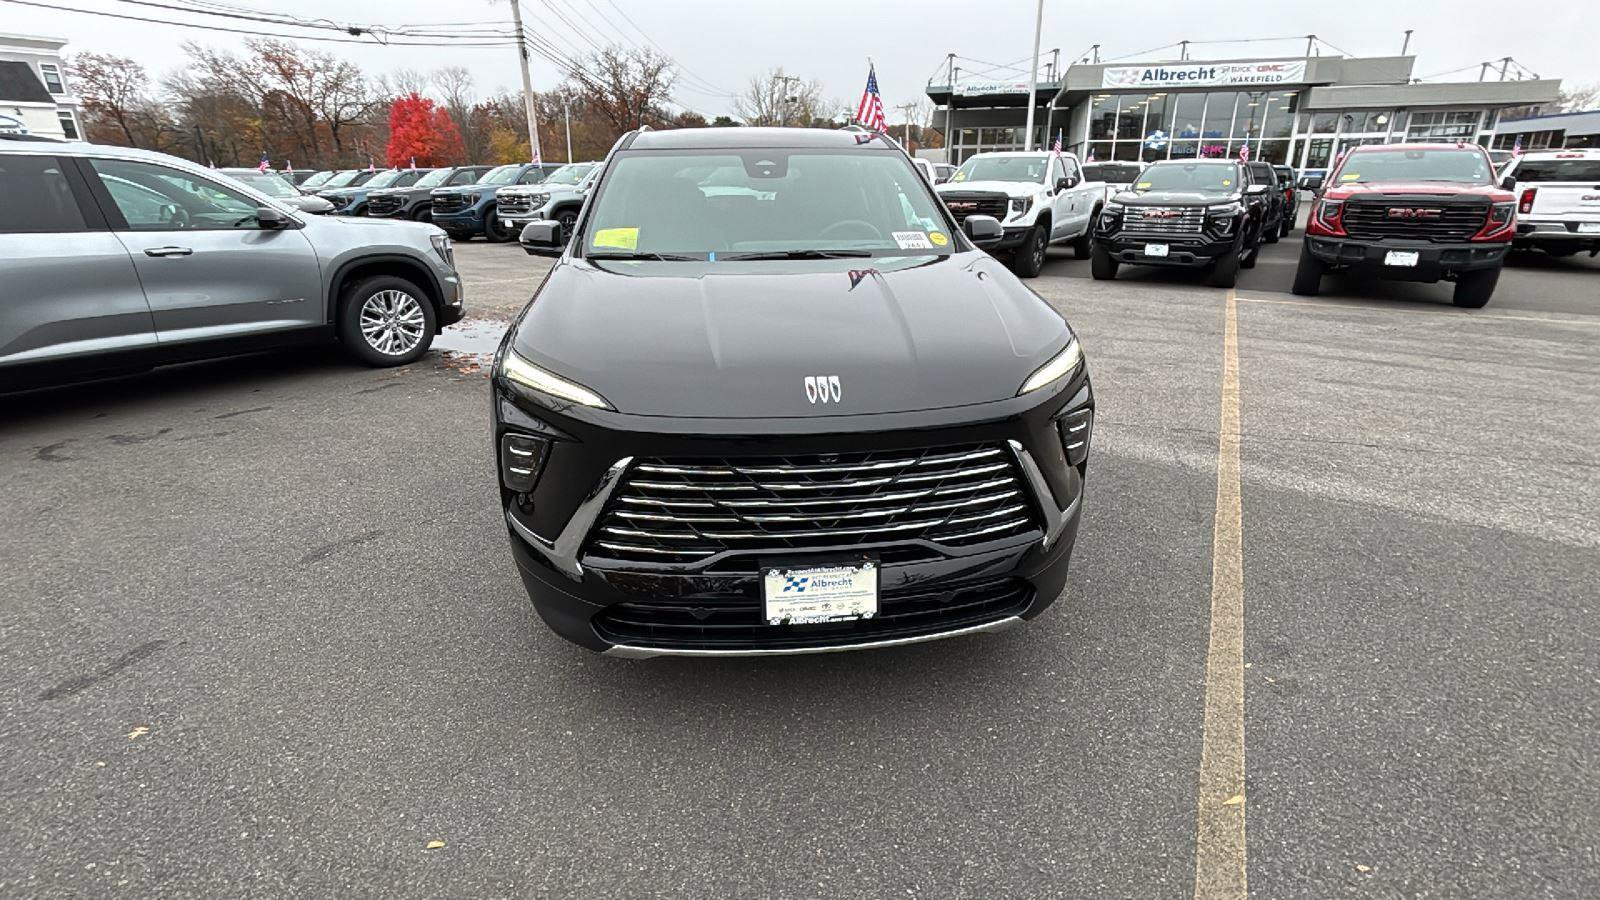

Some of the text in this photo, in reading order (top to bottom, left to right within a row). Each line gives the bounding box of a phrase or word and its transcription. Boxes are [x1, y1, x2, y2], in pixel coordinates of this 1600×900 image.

[1257, 64, 1285, 72] GMC
[1141, 67, 1216, 82] Albrecht
[1230, 75, 1283, 83] WAKEFIELD
[1142, 210, 1184, 219] GMC
[1387, 207, 1443, 218] GMC
[811, 578, 853, 588] Albrecht
[788, 615, 830, 625] Albrecht
